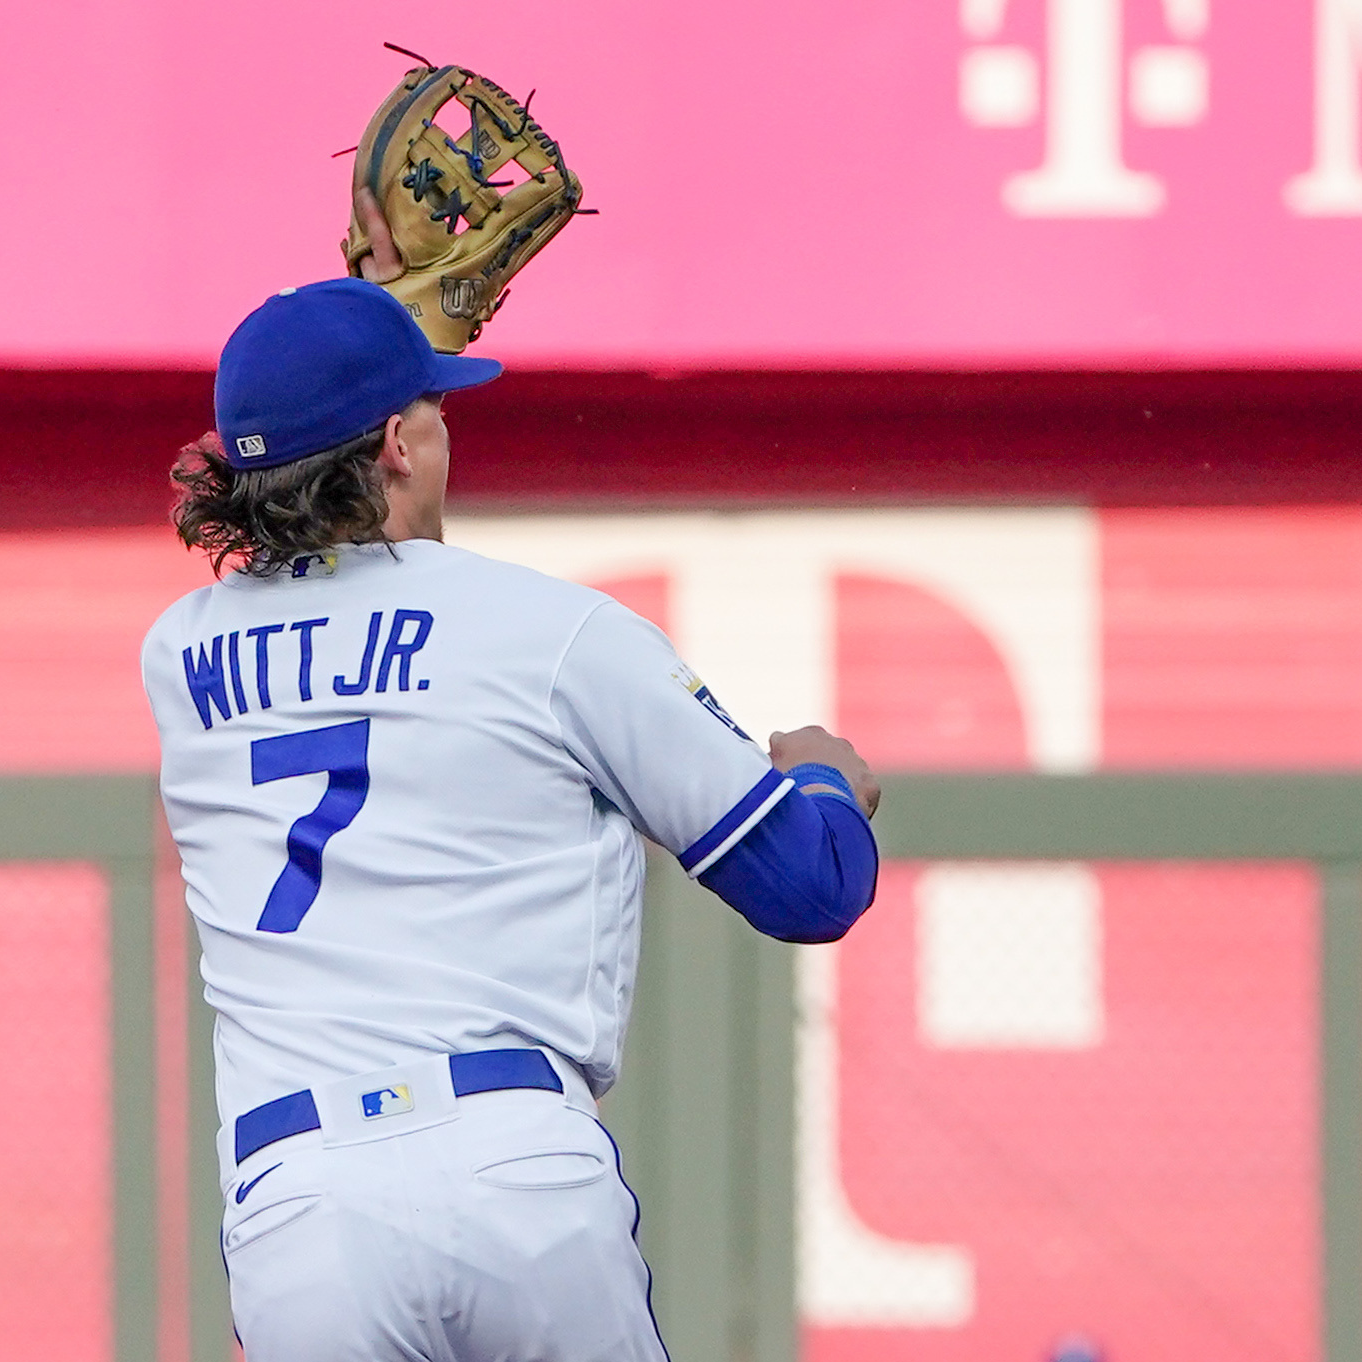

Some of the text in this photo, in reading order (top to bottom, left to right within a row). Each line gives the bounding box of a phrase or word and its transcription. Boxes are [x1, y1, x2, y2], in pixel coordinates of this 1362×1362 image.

[182, 609, 434, 730] WITT JR.
[250, 717, 371, 934] 7
